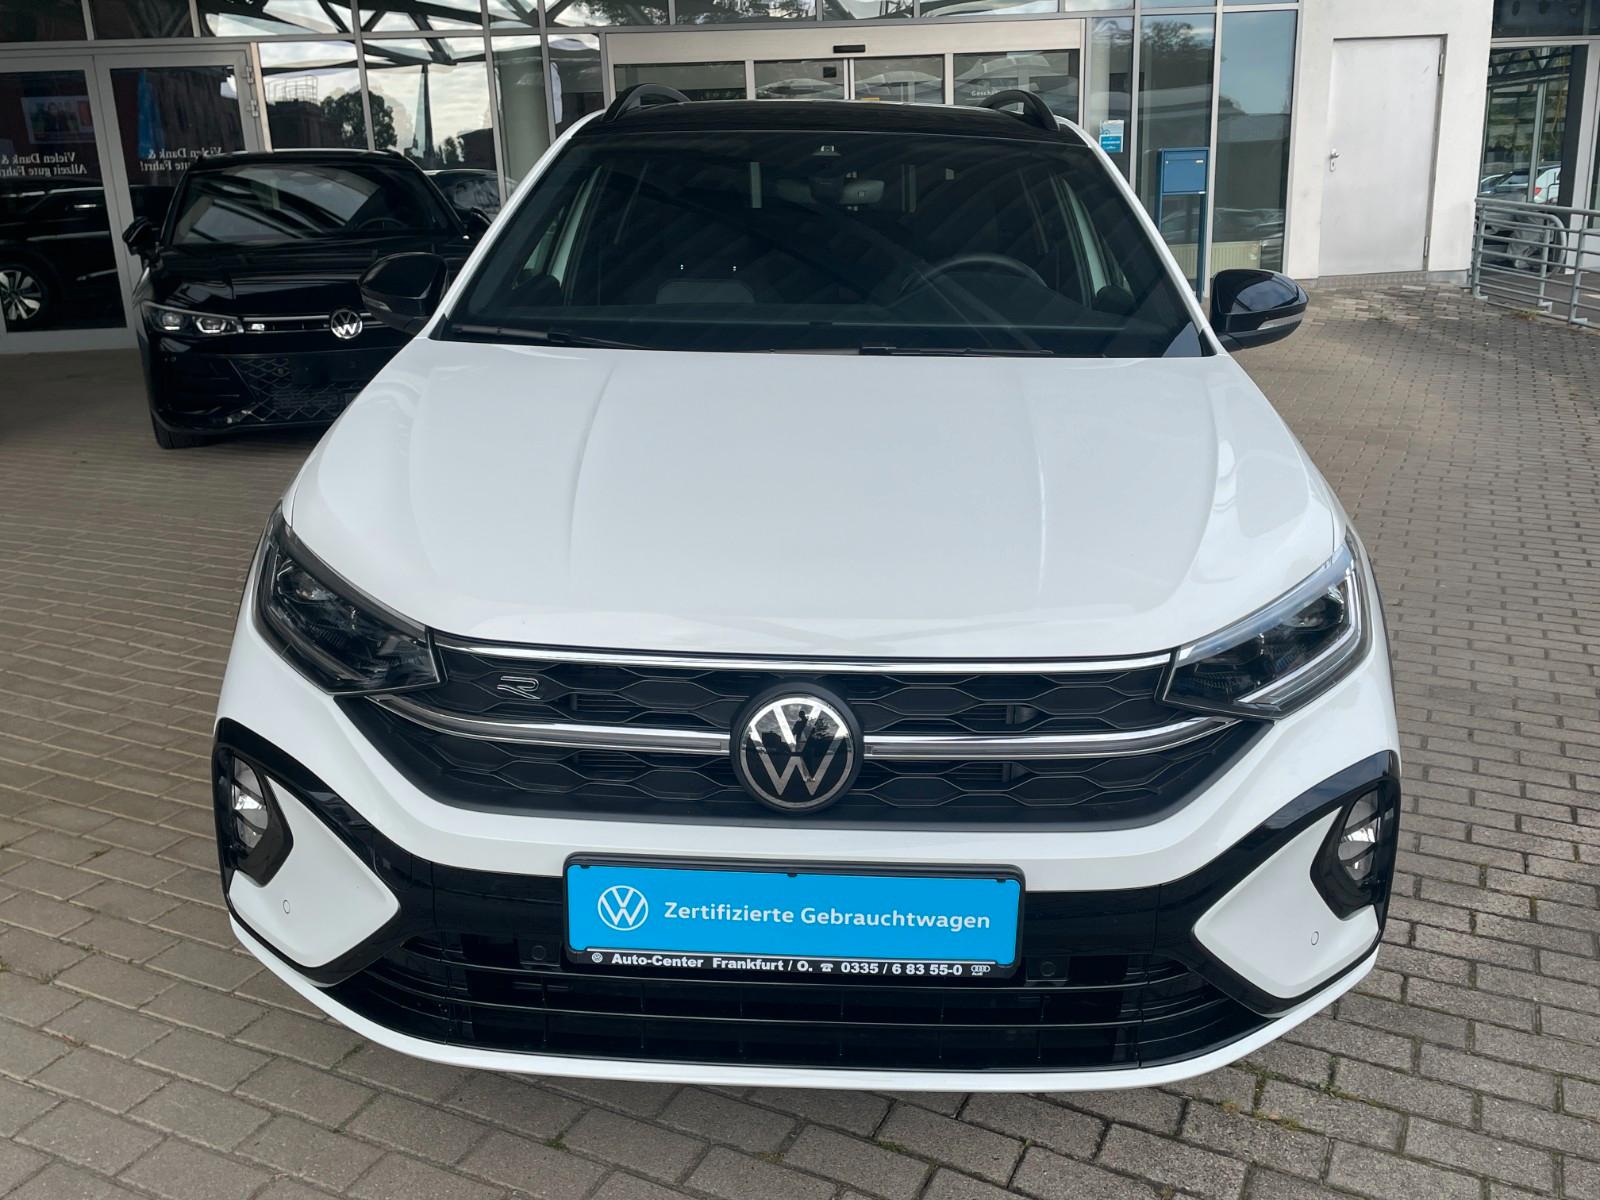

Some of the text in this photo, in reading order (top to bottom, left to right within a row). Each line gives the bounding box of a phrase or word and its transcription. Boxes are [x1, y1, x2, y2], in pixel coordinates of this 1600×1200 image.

[496, 675, 541, 700] R
[744, 700, 851, 802] VW
[598, 885, 649, 931] VW
[663, 901, 991, 932] Zertifizierte Gebrauchtwagen
[611, 953, 704, 968] Auto-Center
[712, 957, 784, 971] Frankfurt
[797, 960, 813, 972] O.
[841, 963, 879, 974] 0335
[891, 963, 902, 975] 6
[905, 964, 925, 975] 83
[929, 964, 963, 976] 55-0
